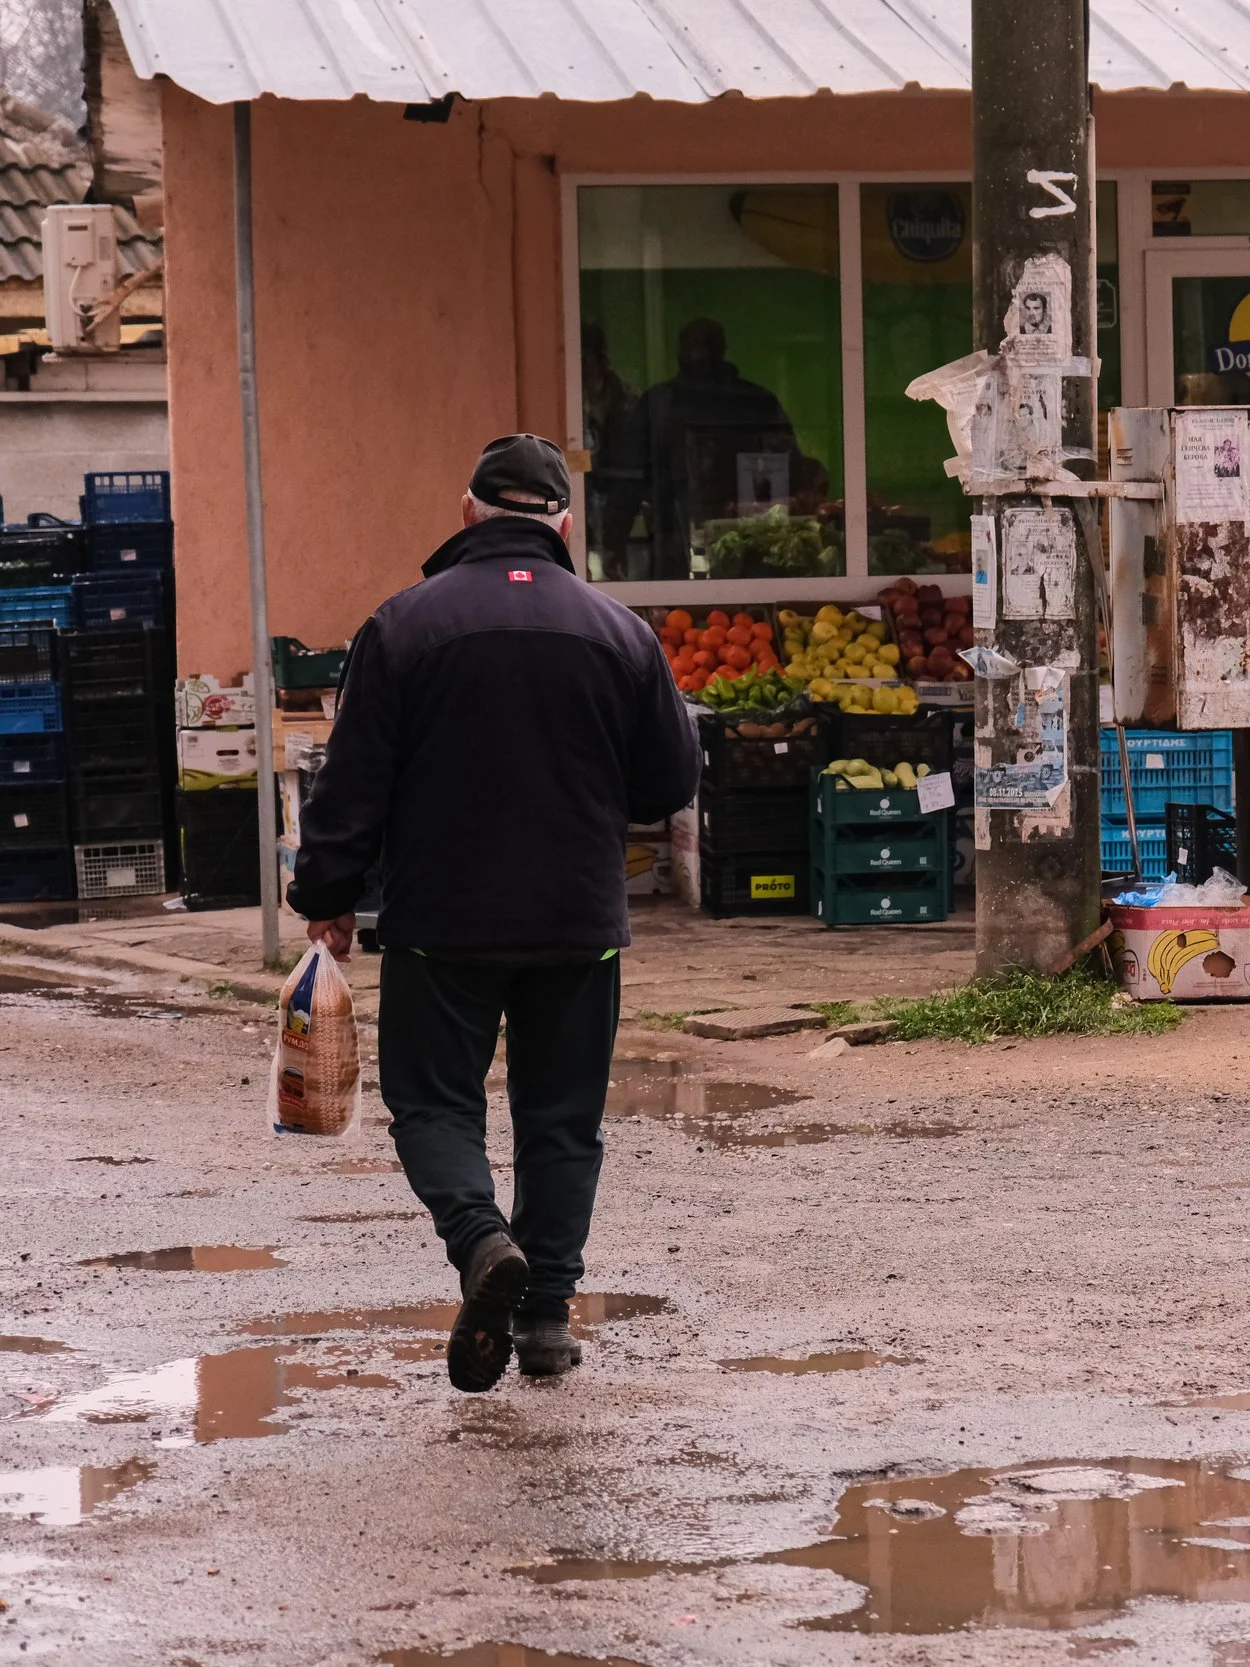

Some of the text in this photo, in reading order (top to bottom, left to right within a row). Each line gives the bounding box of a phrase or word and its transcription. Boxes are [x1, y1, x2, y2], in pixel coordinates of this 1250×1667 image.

[892, 219, 961, 245] Chiquita
[1127, 738, 1187, 748] ΟΥΡΤΙΔΗΣ
[989, 787, 1023, 797] 08.11.2025
